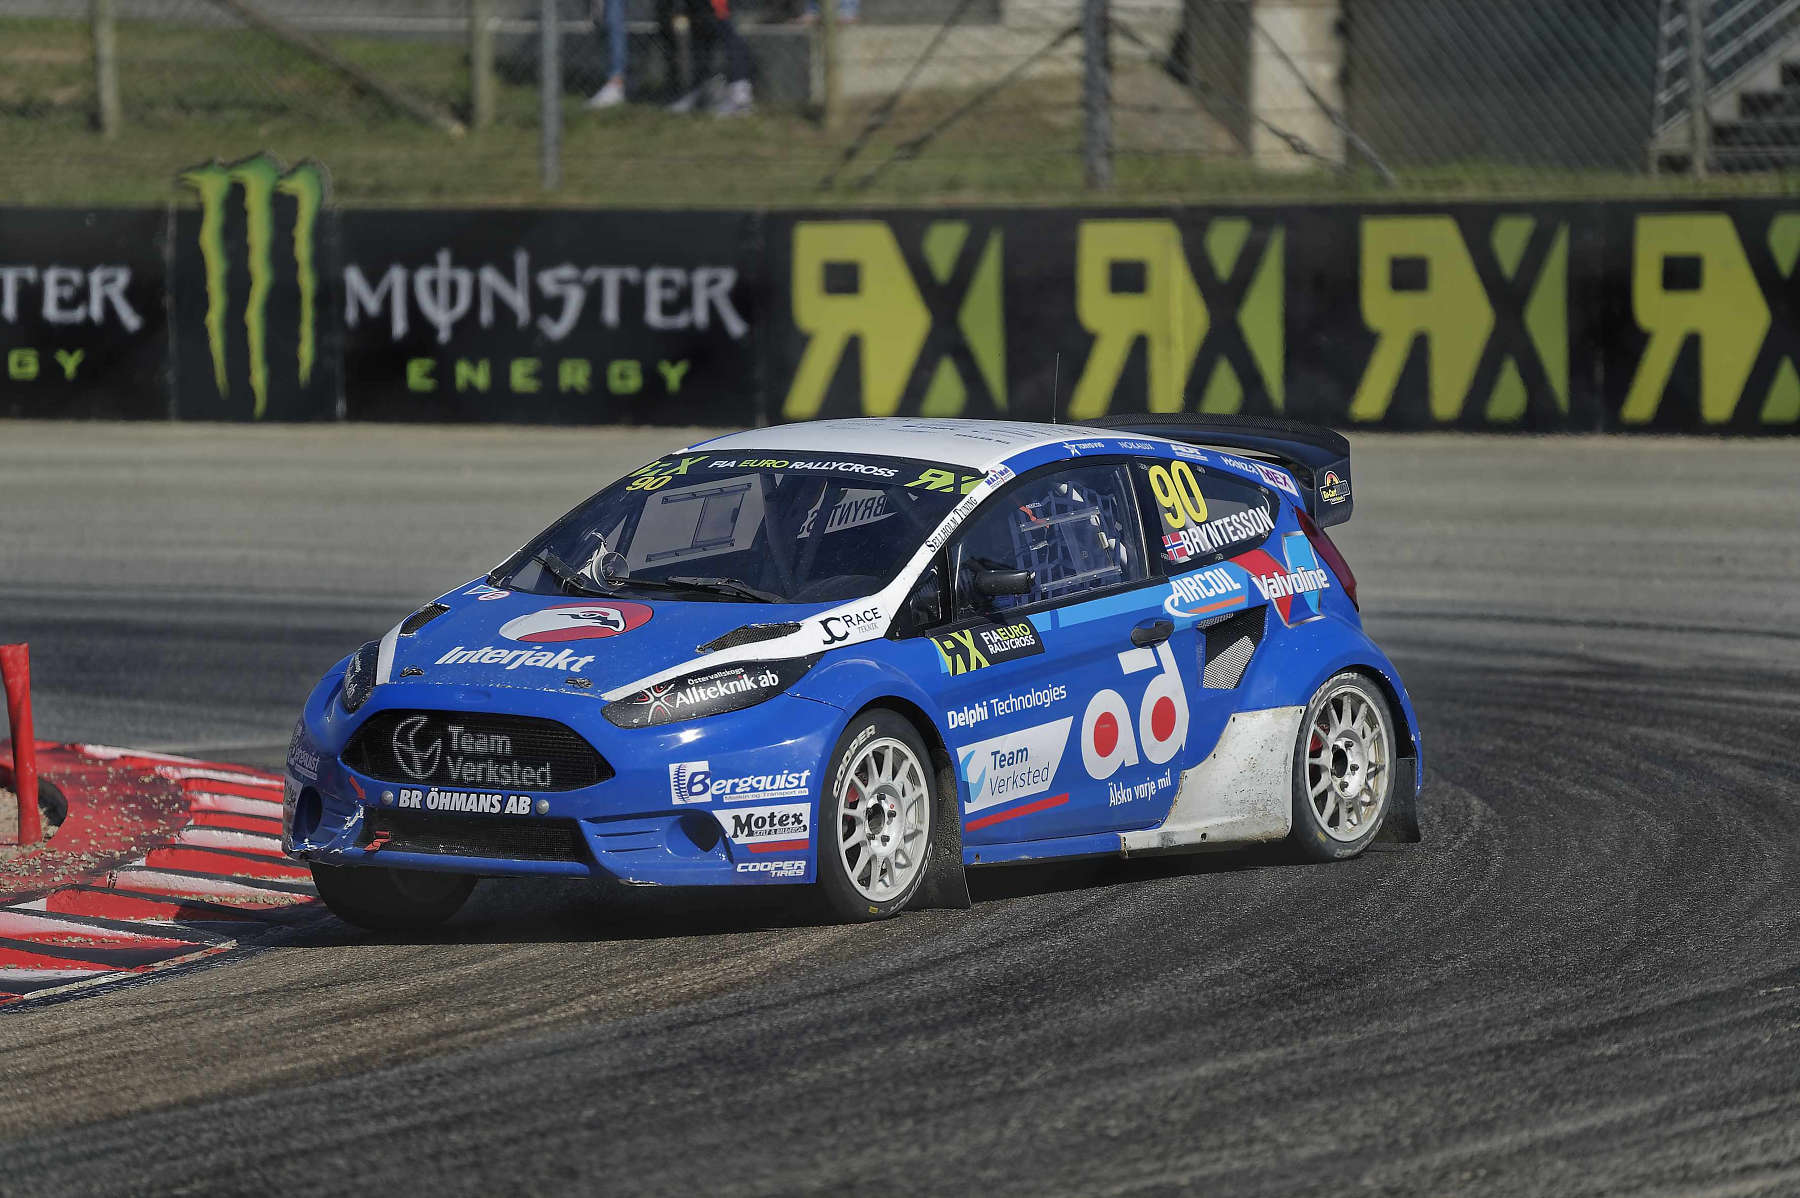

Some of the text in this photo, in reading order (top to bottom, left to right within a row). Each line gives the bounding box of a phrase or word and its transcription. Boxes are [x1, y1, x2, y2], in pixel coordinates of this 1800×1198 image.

[344, 248, 748, 343] MONSTER
[406, 358, 689, 393] ENERGY
[708, 459, 899, 478] FIA EURO RALLYCROSS
[626, 476, 672, 491] 90
[1148, 460, 1208, 529] 90
[953, 497, 978, 521] TUNING
[1180, 506, 1276, 556] BRYNTESSON
[1165, 567, 1241, 614] AIRCOIL
[1252, 566, 1330, 600] Valvoline
[845, 607, 882, 628] RACE
[857, 621, 880, 634] TEKNIK
[988, 635, 1036, 655] RALLYCROSS
[434, 646, 596, 673] Interjakt
[675, 669, 780, 710] Allteknik ab
[947, 684, 1067, 729] Delphi Technologies
[447, 725, 513, 755] Team
[446, 757, 551, 788] Verksted
[991, 747, 1029, 771] Team
[686, 769, 811, 797] Bergquist
[990, 762, 1050, 796] Verksted
[1109, 769, 1171, 807] Älska varje mil
[399, 788, 532, 815] BR ÖHMANS AB
[731, 811, 804, 838] Motex
[736, 860, 806, 873] COOPER
[770, 869, 805, 878] TIRES
